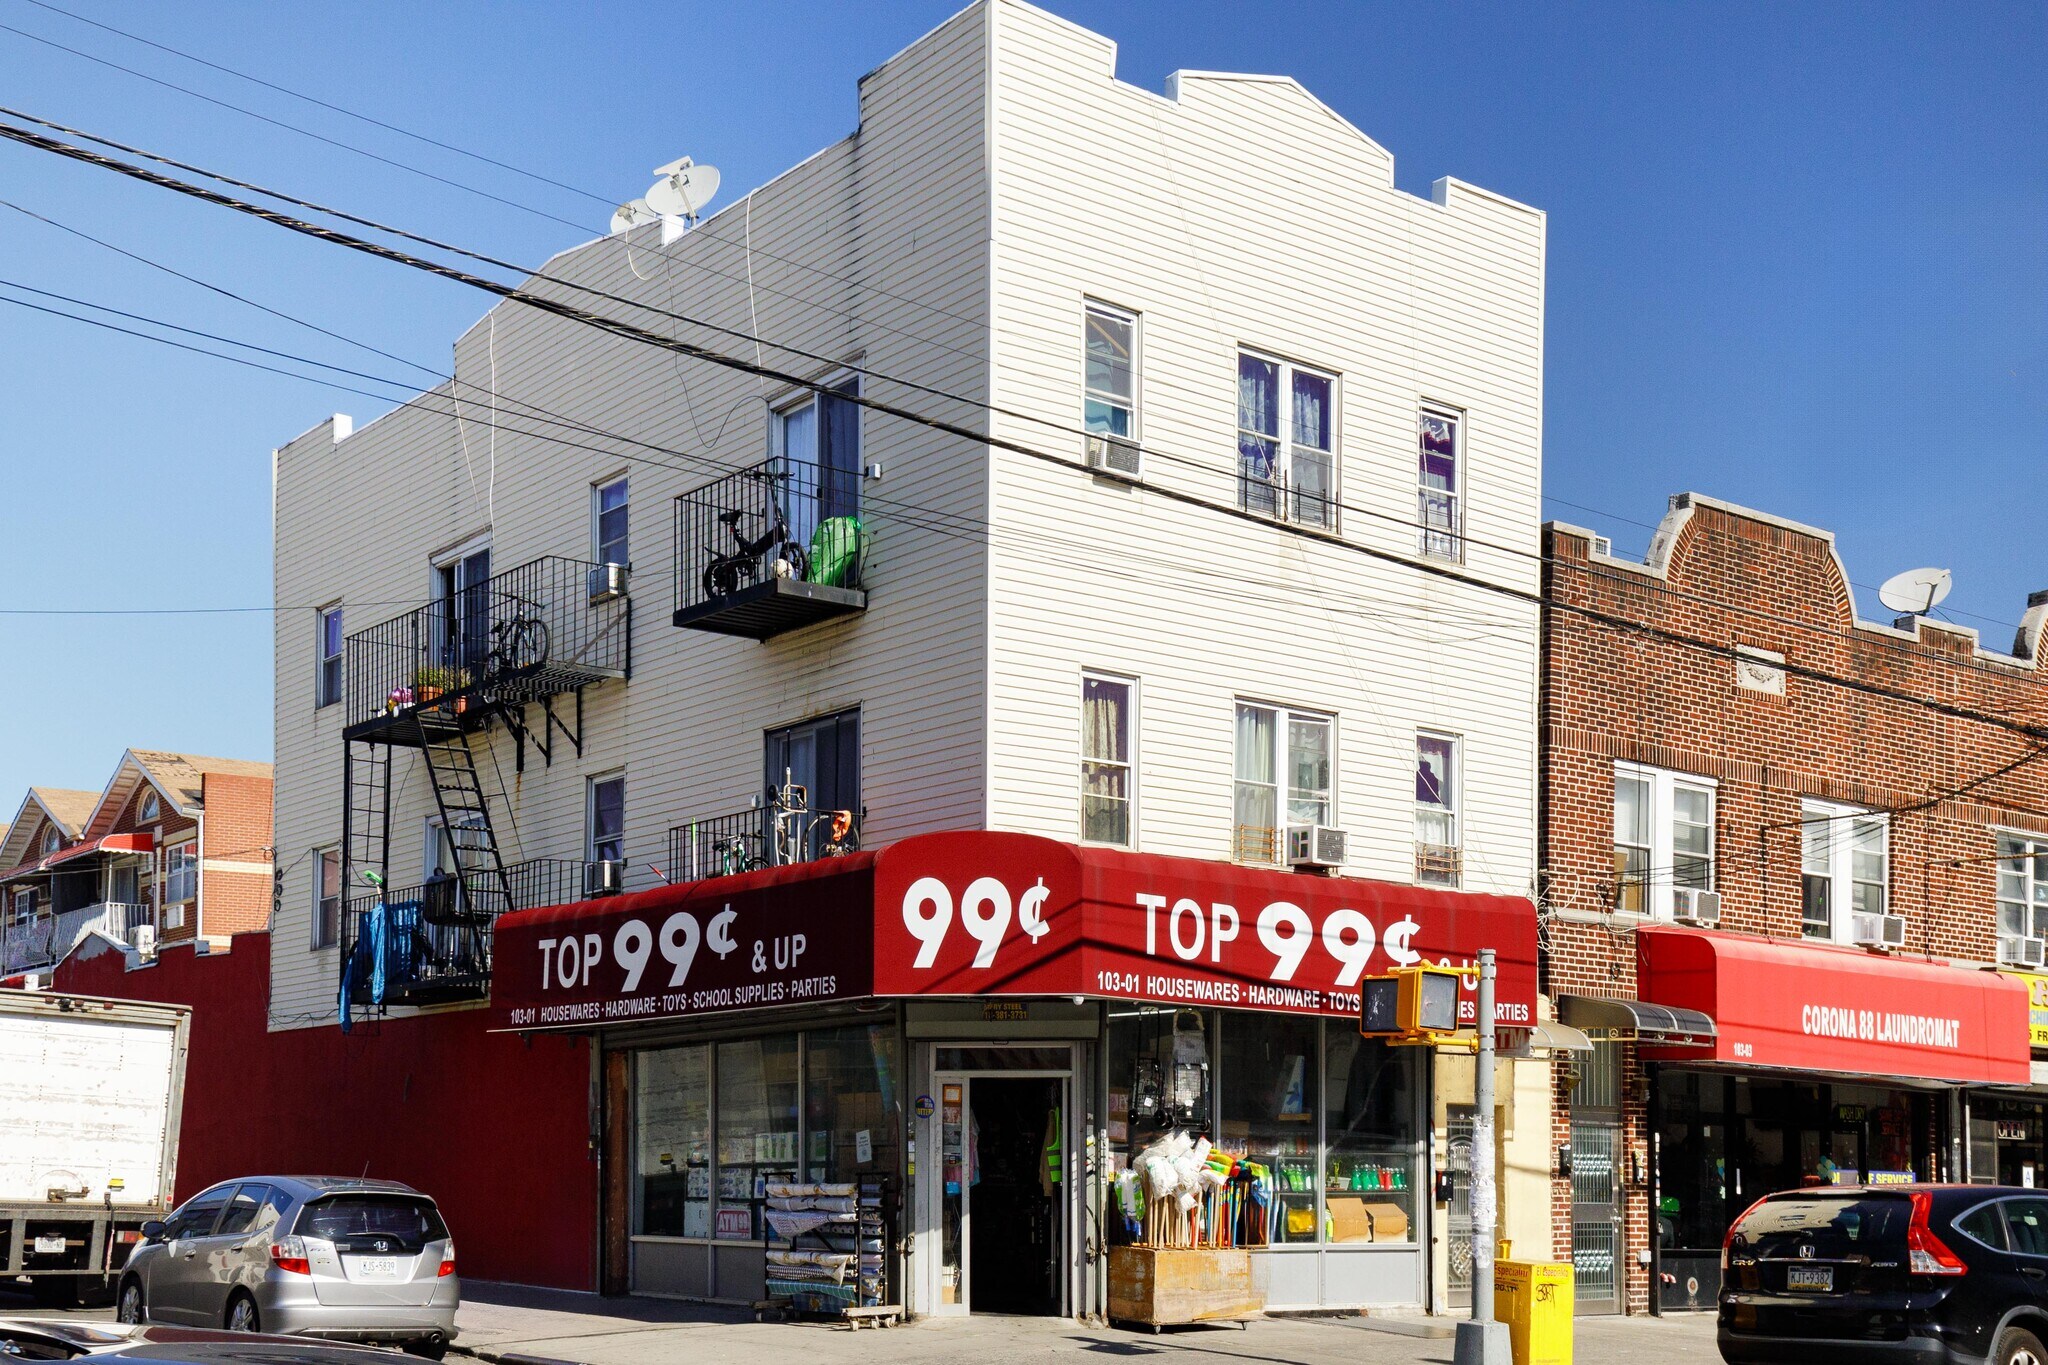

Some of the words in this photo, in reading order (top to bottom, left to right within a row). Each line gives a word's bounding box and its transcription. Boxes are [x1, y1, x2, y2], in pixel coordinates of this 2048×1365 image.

[902, 876, 1051, 969] 99¢
[1136, 892, 1240, 963] TOP
[538, 933, 602, 990] TOP
[613, 903, 739, 993] 99¢
[751, 940, 768, 973] &
[774, 933, 807, 970] UP
[510, 1009, 536, 1025] 103-01
[540, 1002, 601, 1023] HOUSEWARES
[605, 996, 657, 1018] HARDWARE
[662, 993, 687, 1011] TOYS
[692, 988, 732, 1009] SCHOOL
[734, 982, 784, 1005] SUPPLIES
[791, 975, 837, 999] PARTIES
[1097, 970, 1141, 994] 103-01
[1146, 975, 1241, 1003] HOUSEWARES
[1248, 985, 1320, 1009] HARDWARE
[1327, 991, 1361, 1012] TOYS
[1495, 1028, 1526, 1048] TM
[1802, 1004, 1857, 1039] CORONA
[1859, 1011, 1874, 1040] 88
[1876, 1013, 1960, 1048] LAUNDROMAT
[180, 1047, 187, 1057] 7
[1998, 1120, 2025, 1137] OPEN
[1875, 1173, 1913, 1185] SERVICE
[2025, 1171, 2031, 1183] A
